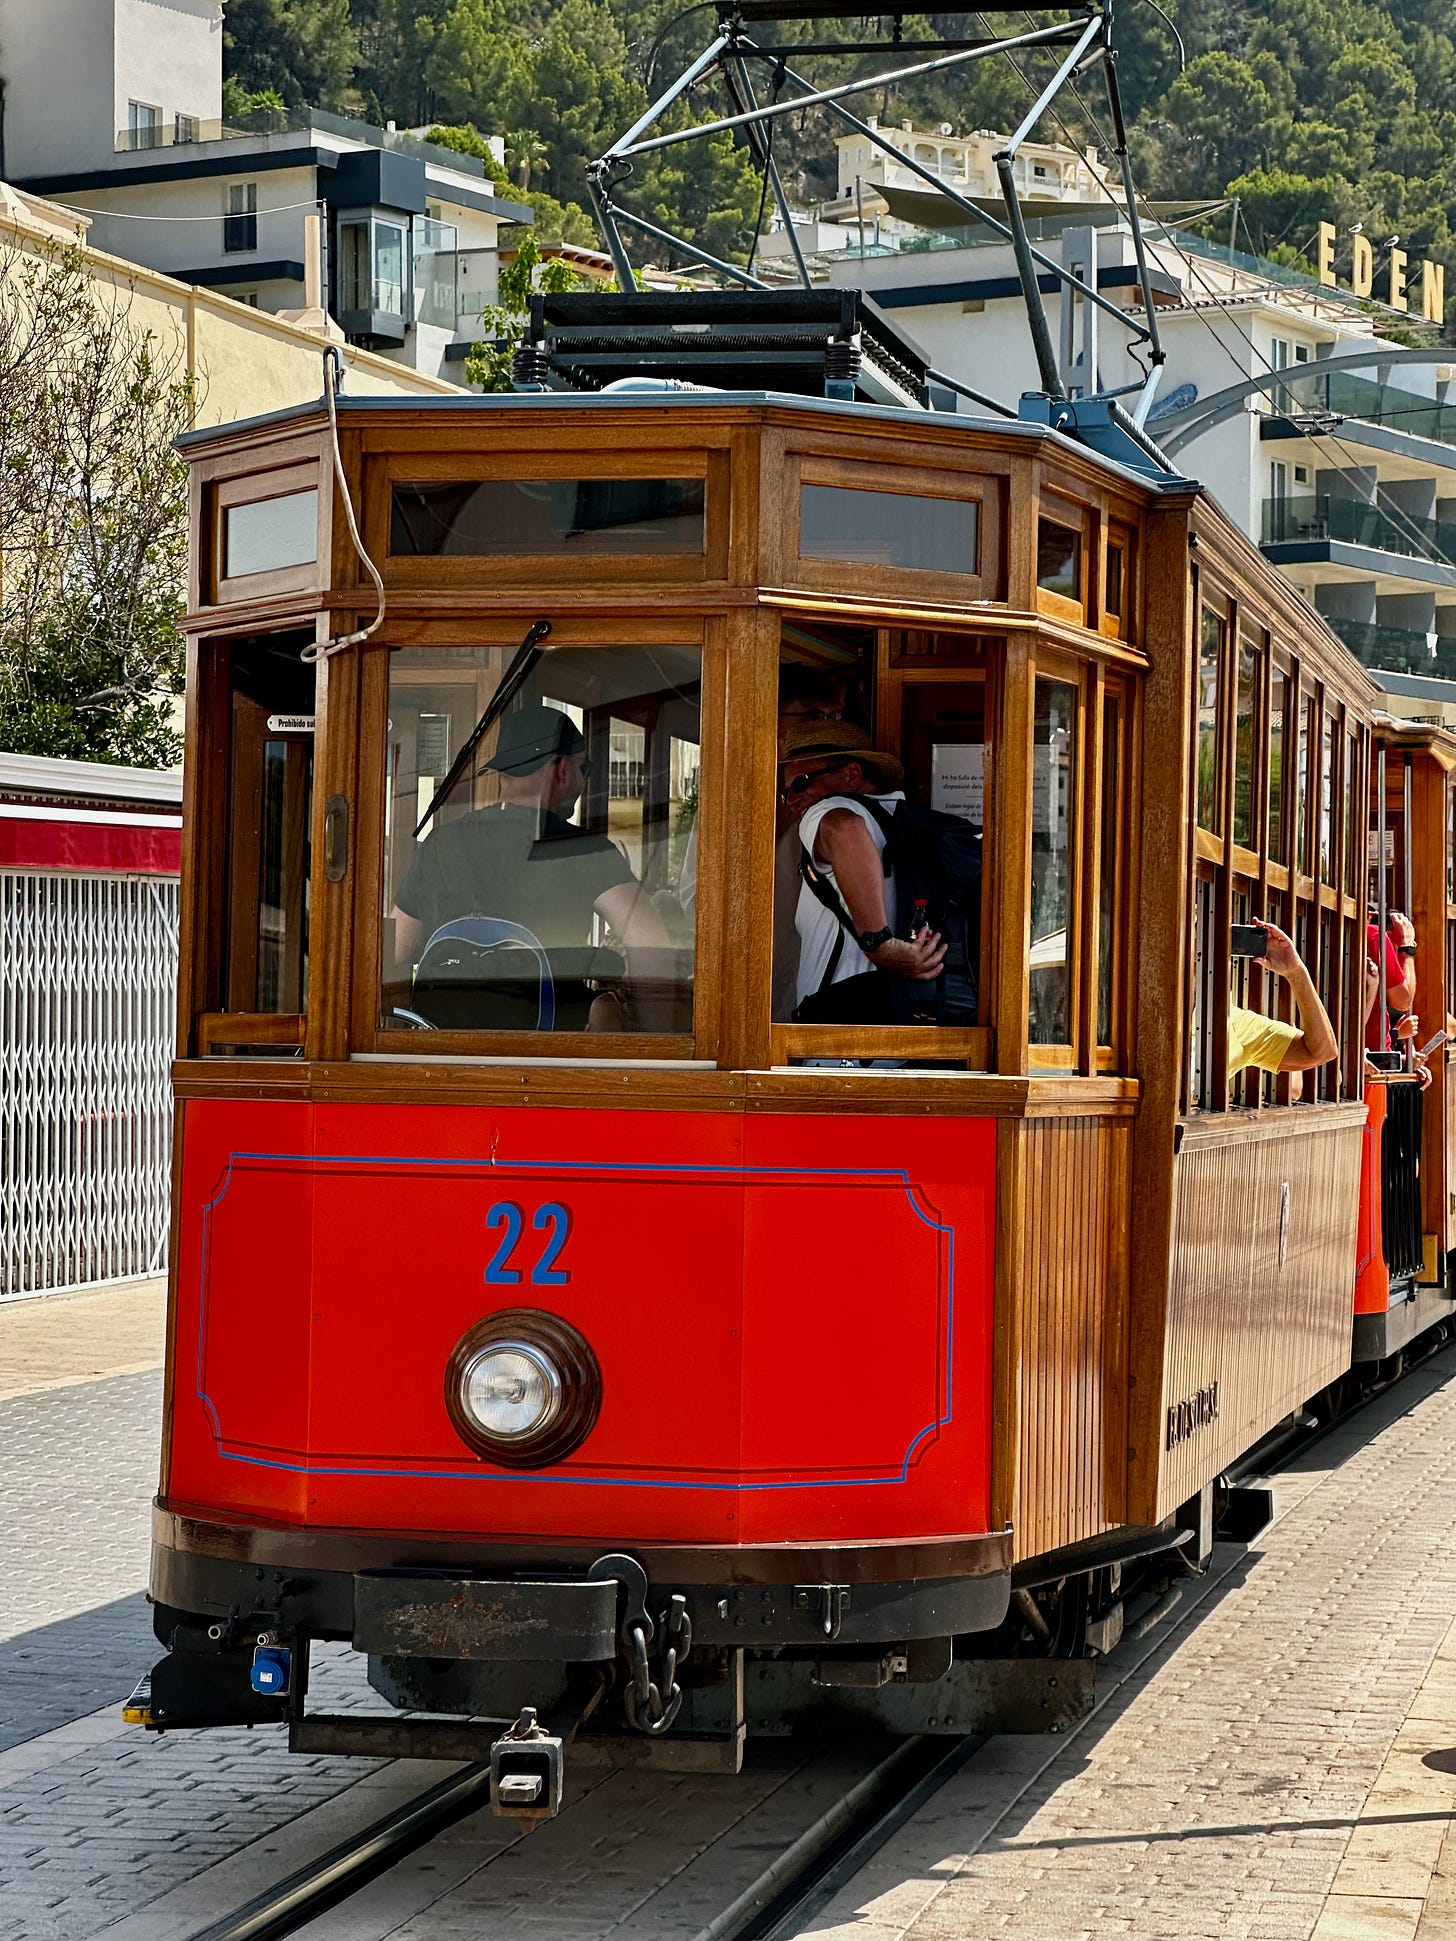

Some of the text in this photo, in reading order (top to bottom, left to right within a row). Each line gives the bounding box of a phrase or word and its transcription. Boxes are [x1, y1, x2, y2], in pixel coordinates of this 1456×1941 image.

[1318, 220, 1444, 325] EDEN
[278, 718, 306, 728] Prohibido
[484, 1202, 571, 1285] 22
